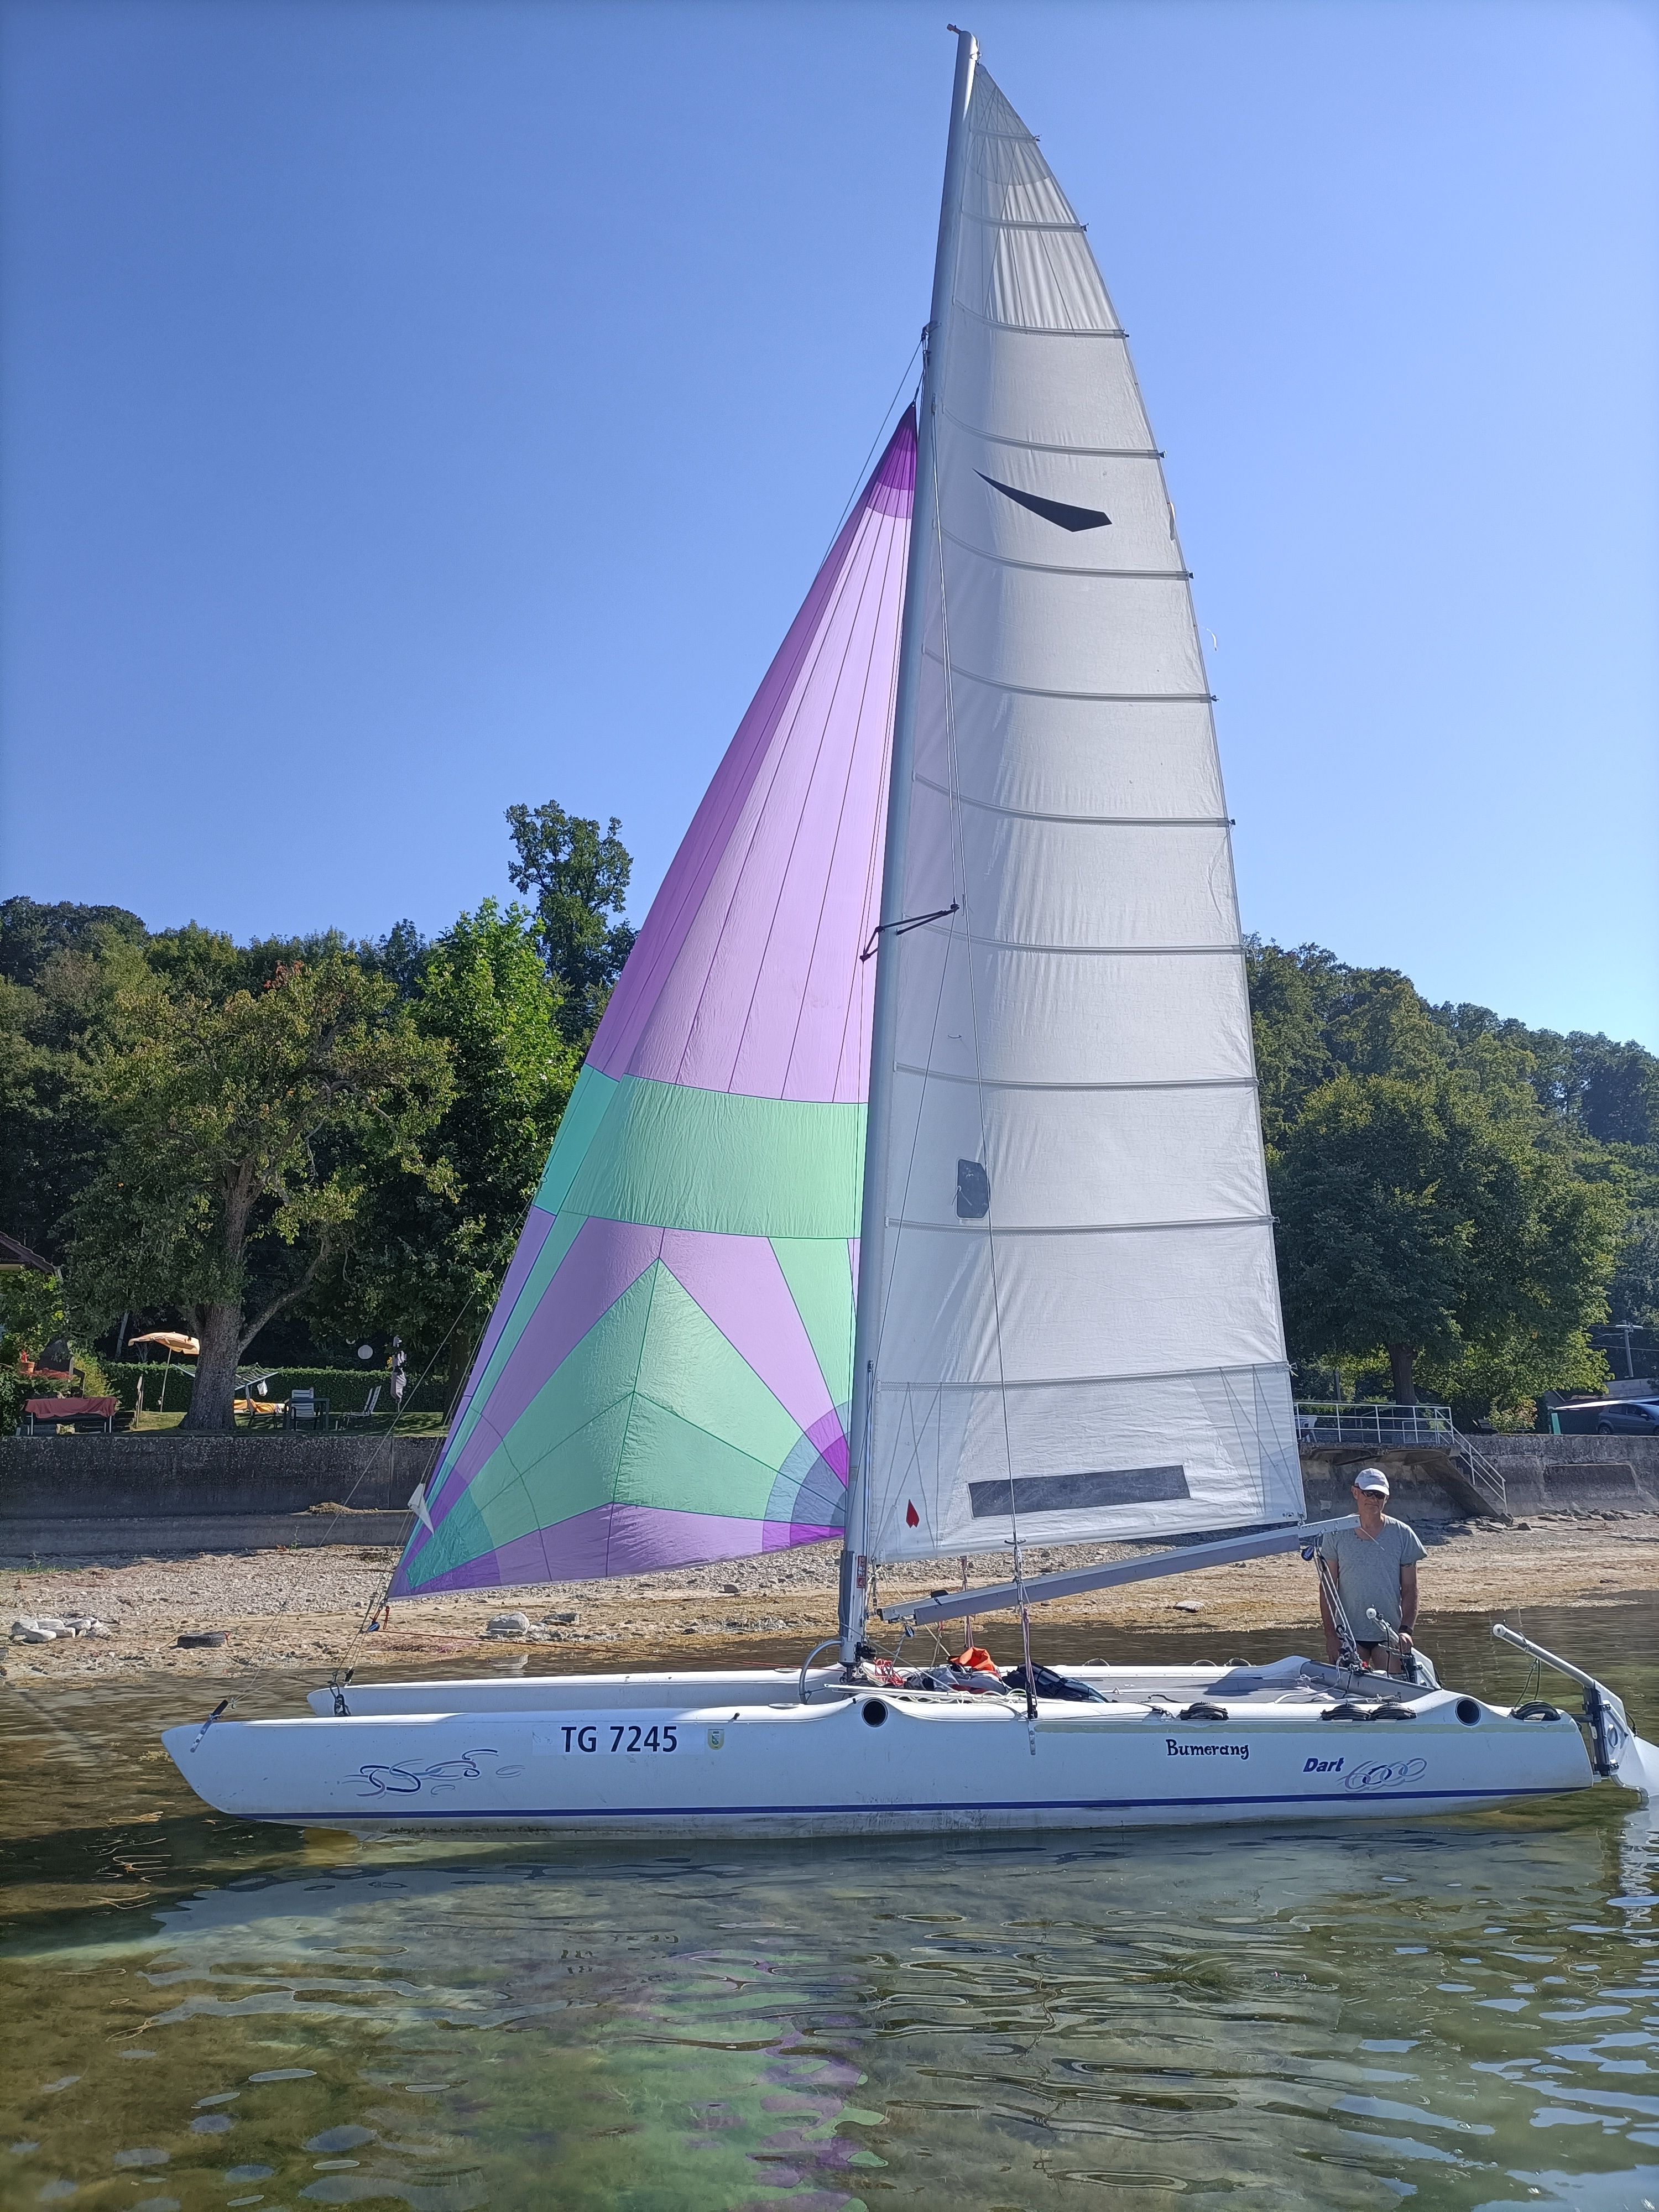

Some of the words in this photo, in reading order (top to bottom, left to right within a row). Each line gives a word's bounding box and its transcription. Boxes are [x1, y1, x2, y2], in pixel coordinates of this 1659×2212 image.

[561, 1726, 597, 1752] TG
[610, 1725, 677, 1752] 7245
[1165, 1739, 1249, 1760] Bumerang
[1303, 1757, 1344, 1772] Dart
